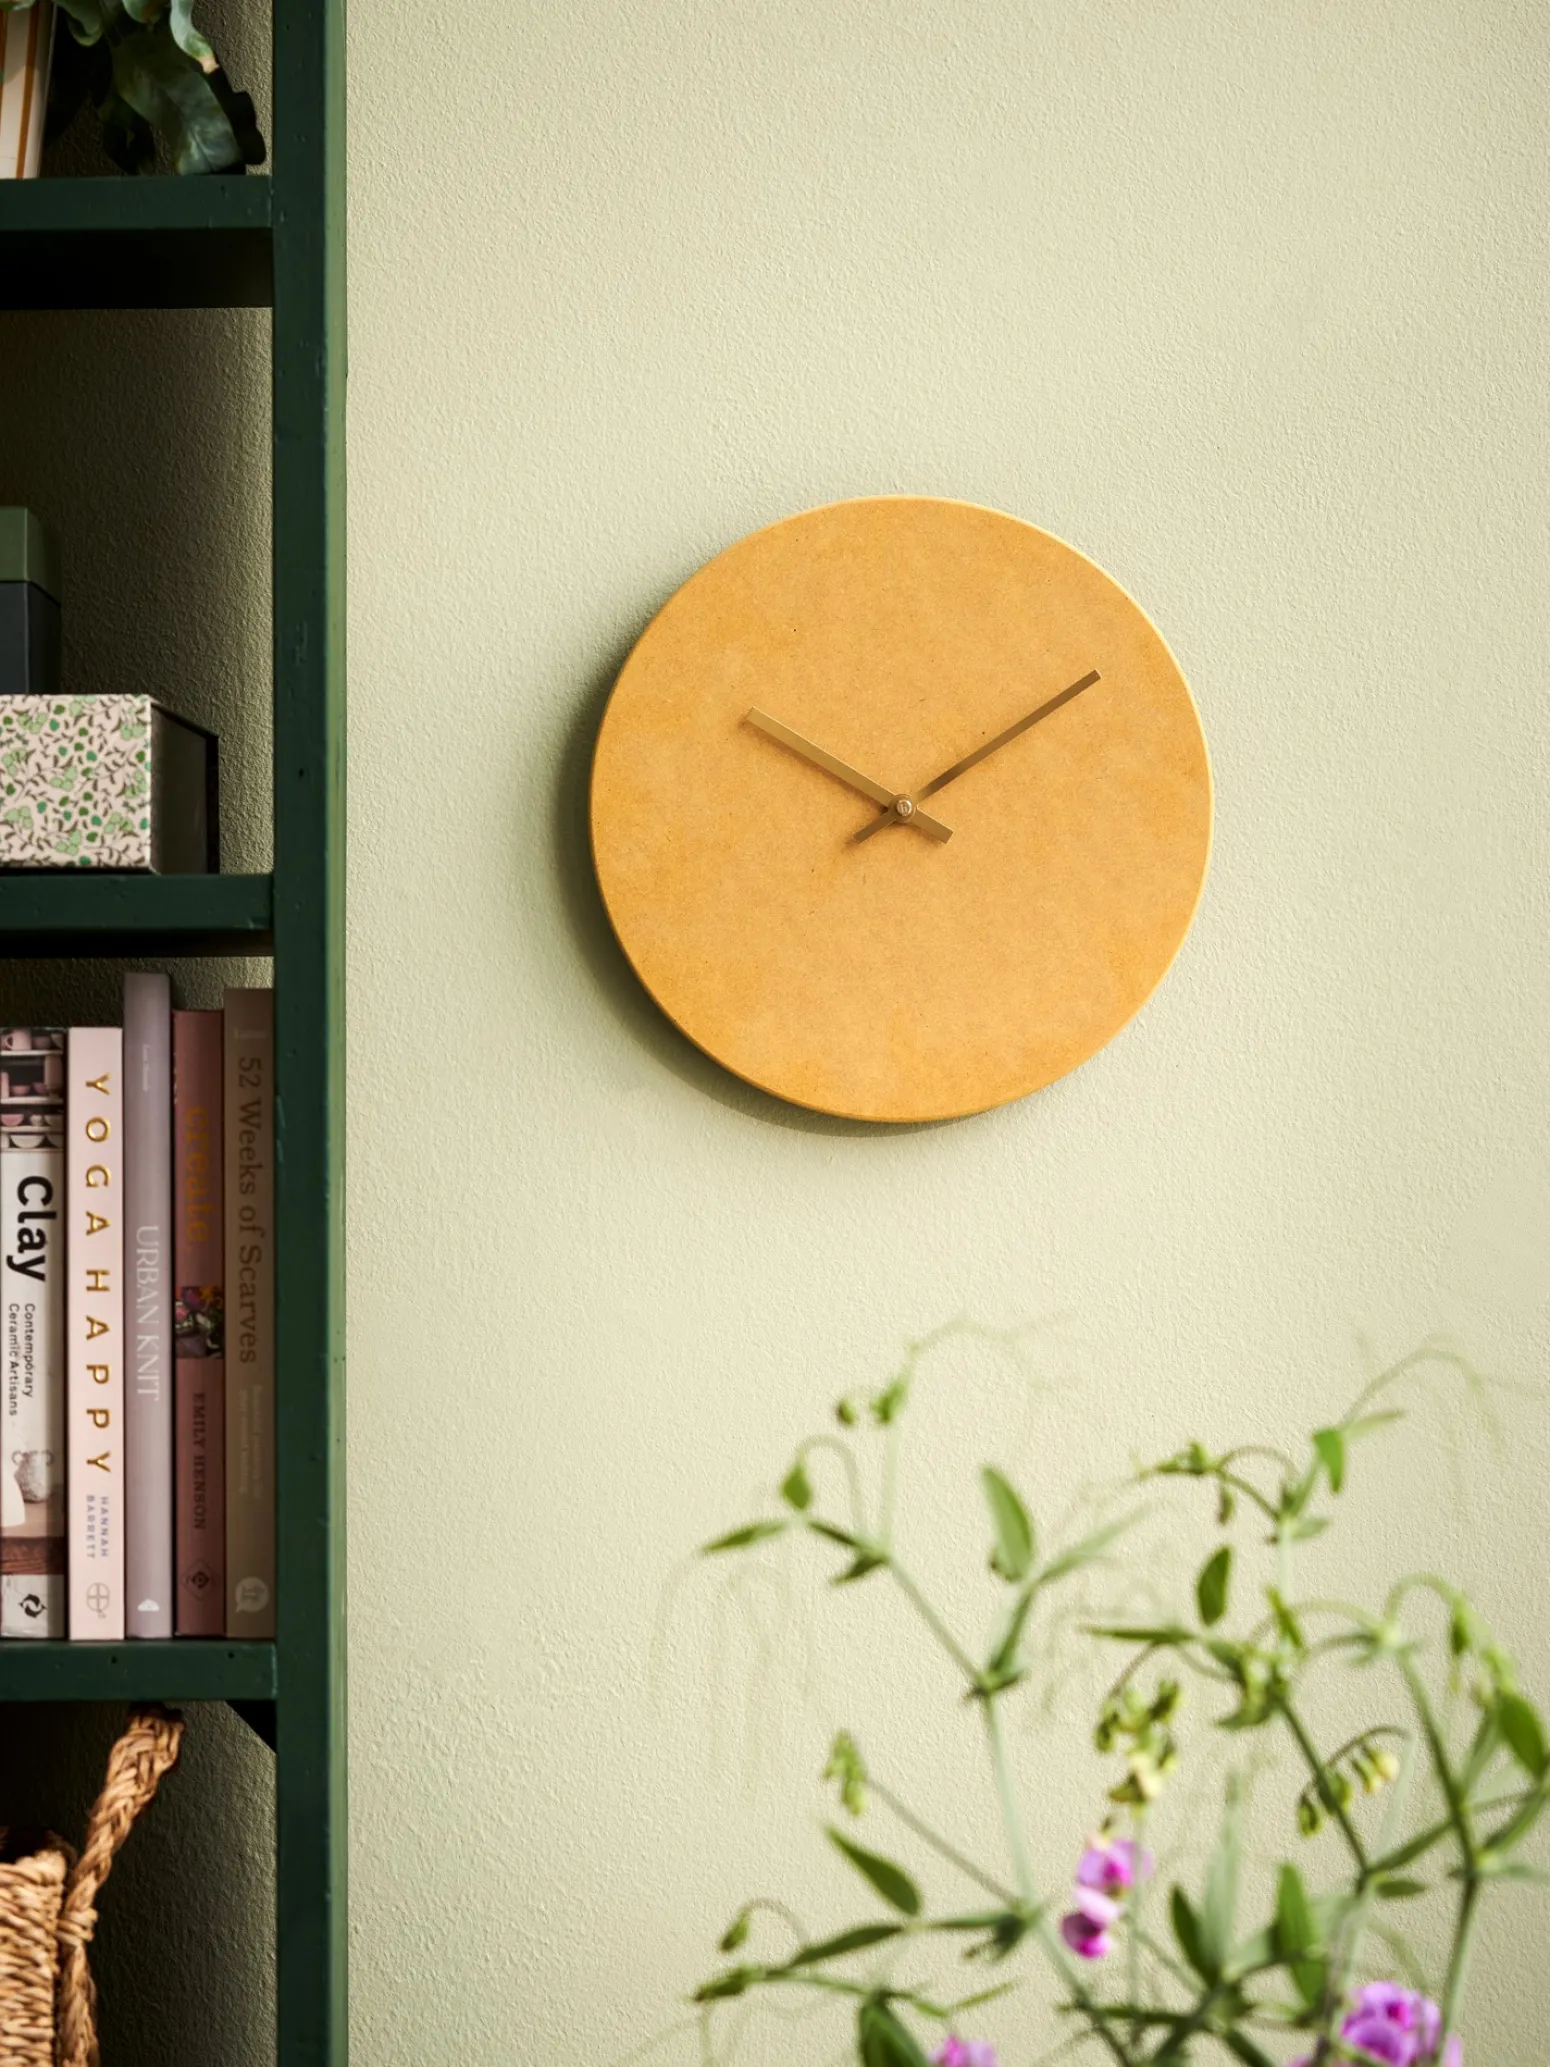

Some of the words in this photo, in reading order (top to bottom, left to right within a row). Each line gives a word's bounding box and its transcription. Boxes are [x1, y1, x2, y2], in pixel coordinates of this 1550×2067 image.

[238, 1056, 262, 1089] 52
[85, 1073, 111, 1237] YOGA
[238, 1100, 263, 1195] Weeks
[6, 1175, 57, 1282] Clay
[238, 1203, 265, 1237] of
[136, 1226, 160, 1324] URBAN
[238, 1244, 263, 1364] Scarves
[8, 1303, 20, 1359] Ceramic
[22, 1303, 36, 1398] Contemporary
[8, 1361, 19, 1417] Artisans
[85, 1269, 112, 1473] HAPPY
[136, 1335, 160, 1400] KNIT
[193, 1392, 206, 1448] EMILY
[86, 1494, 96, 1560] BARRETT
[100, 1496, 109, 1558] HANNAH
[193, 1455, 206, 1530] HENSON
